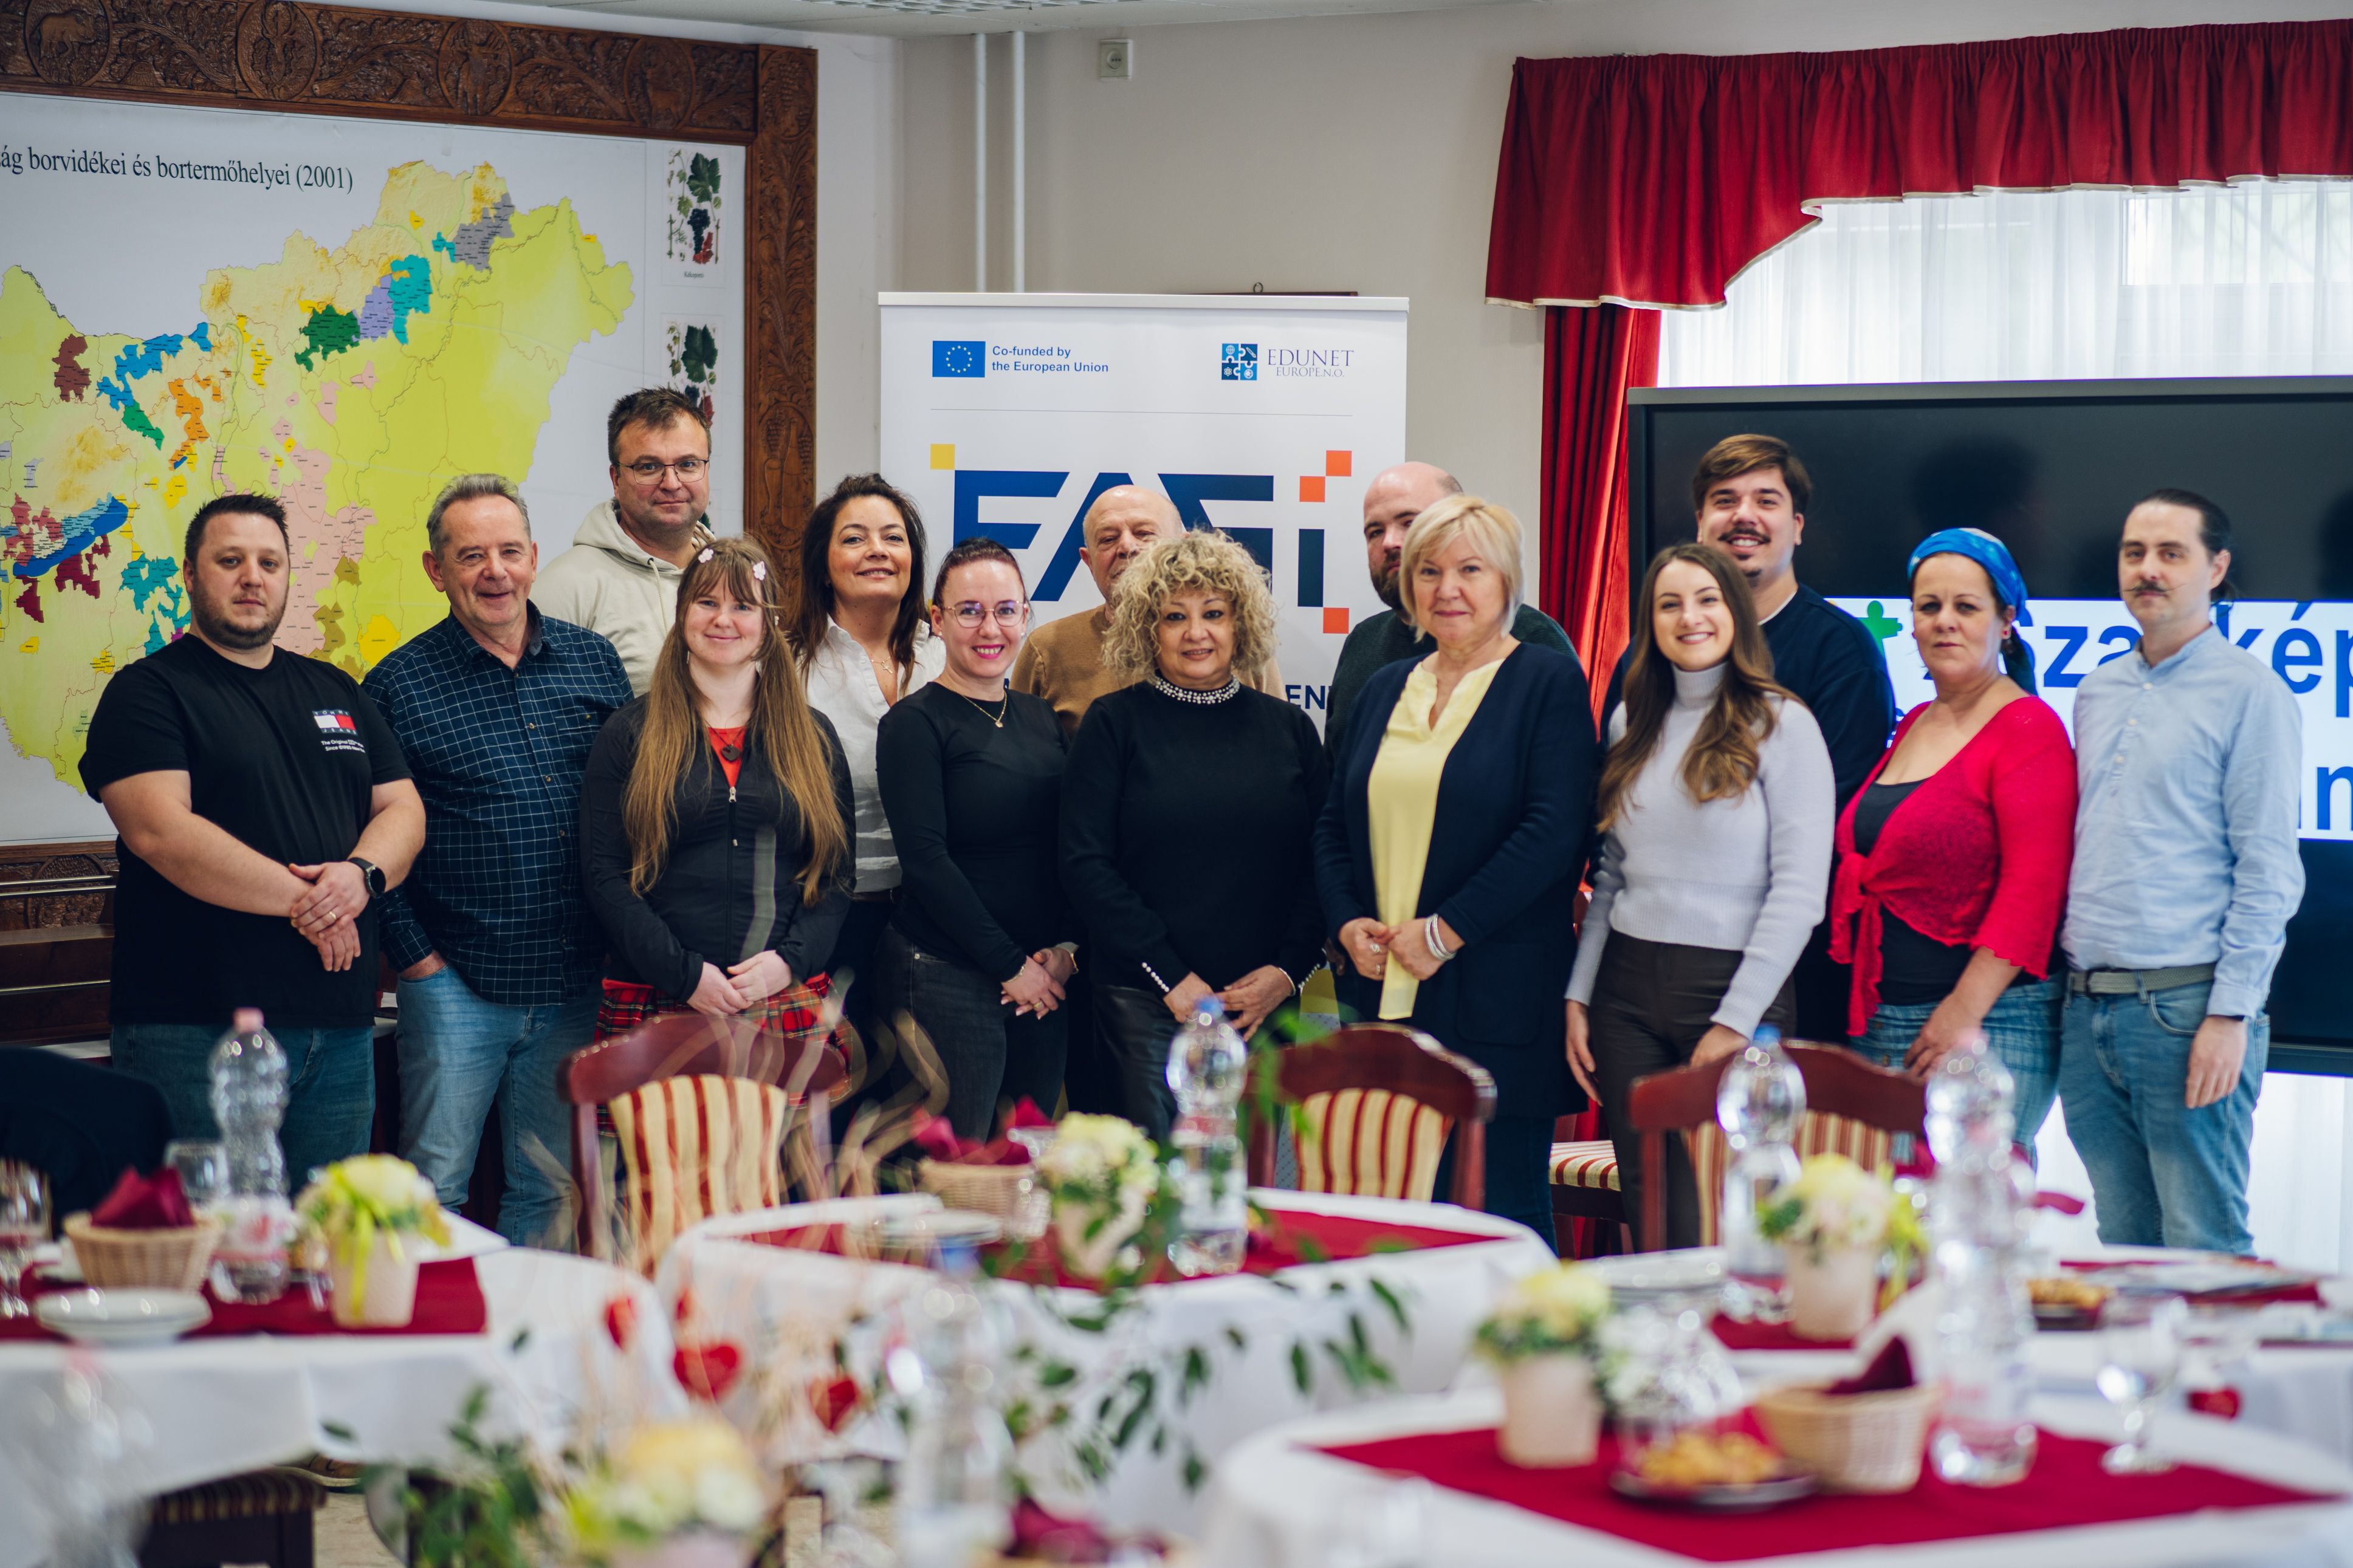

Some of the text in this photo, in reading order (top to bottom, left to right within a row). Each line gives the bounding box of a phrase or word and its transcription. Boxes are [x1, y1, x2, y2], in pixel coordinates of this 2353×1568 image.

[0, 145, 353, 194] ág borvidékei és bortermőhelyei (2001)
[992, 346, 1071, 358] Co-funded by
[1268, 349, 1355, 367] EDUNET
[992, 361, 1108, 373] the European Union
[1285, 684, 1333, 710] EN
